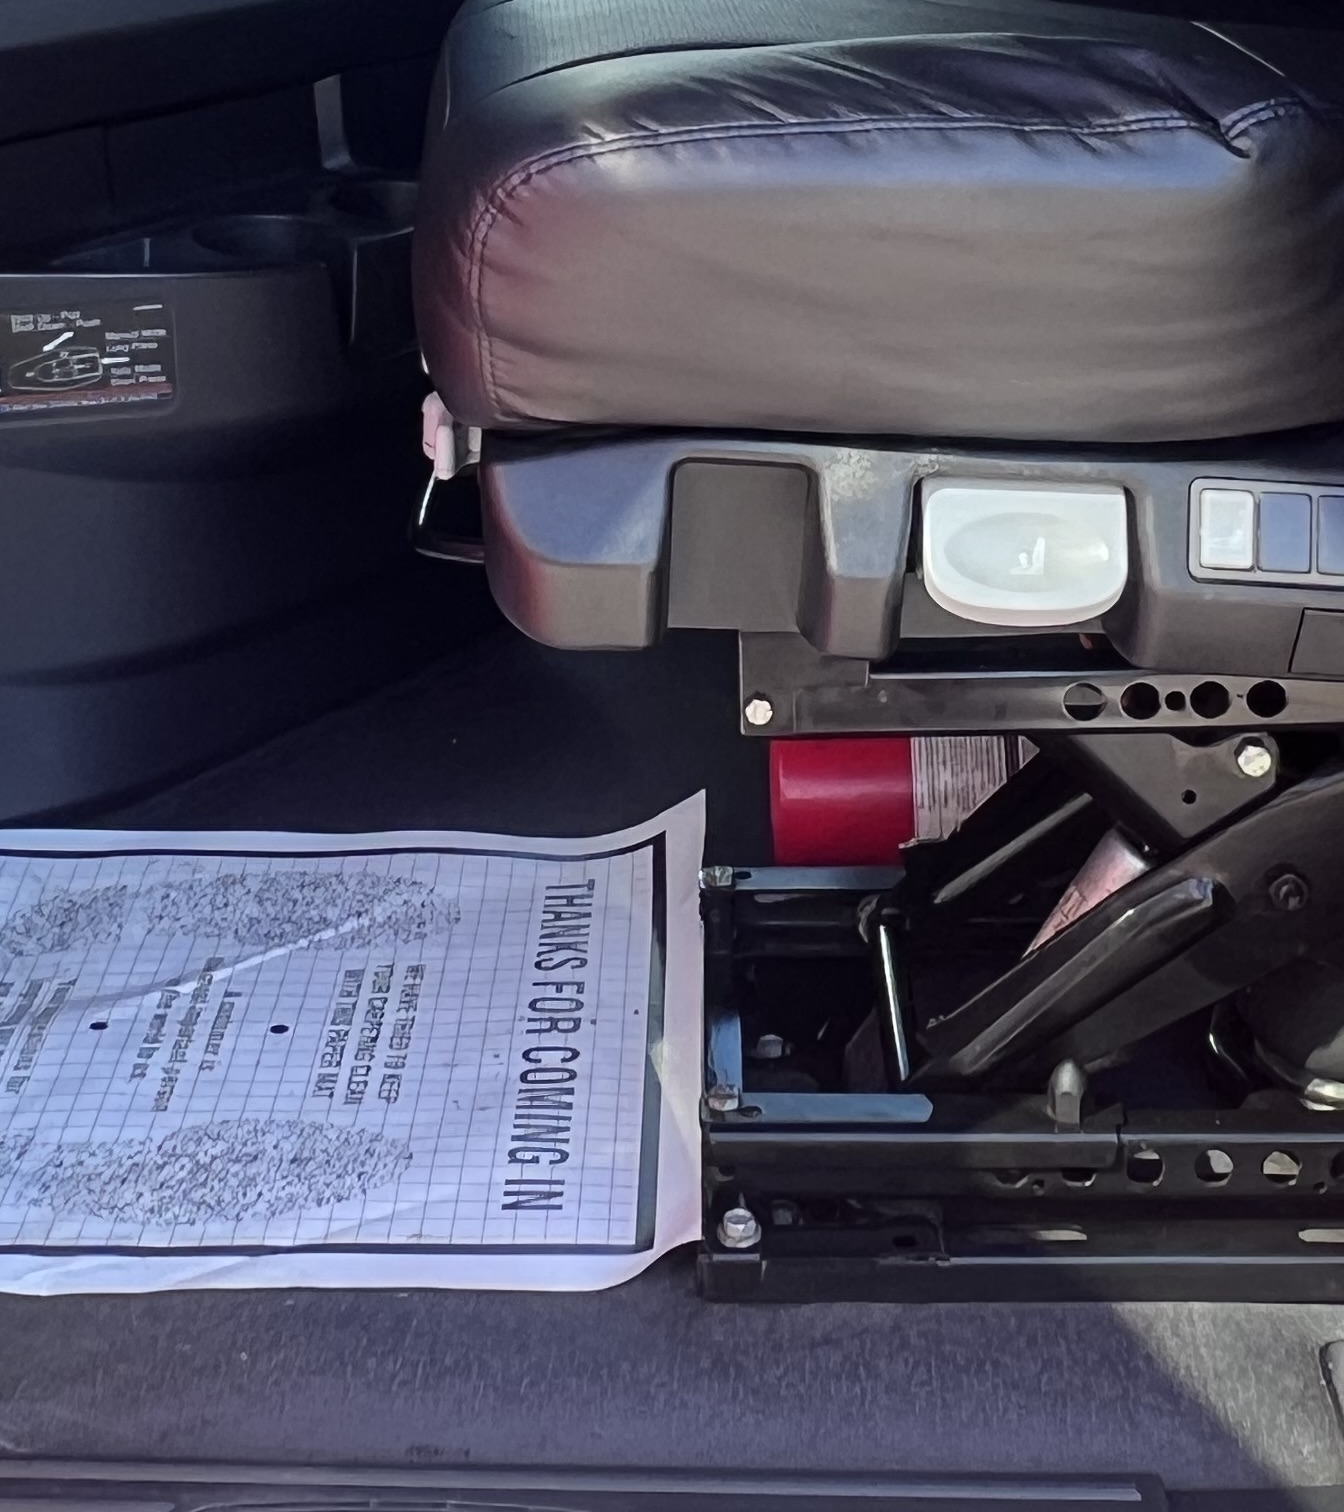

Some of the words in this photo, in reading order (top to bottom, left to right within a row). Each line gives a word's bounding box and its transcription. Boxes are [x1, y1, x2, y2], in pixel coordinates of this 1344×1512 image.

[533, 879, 596, 972] THANKS
[525, 981, 586, 1034] FOR
[506, 1046, 580, 1165] COMING
[501, 1179, 566, 1211] IN
